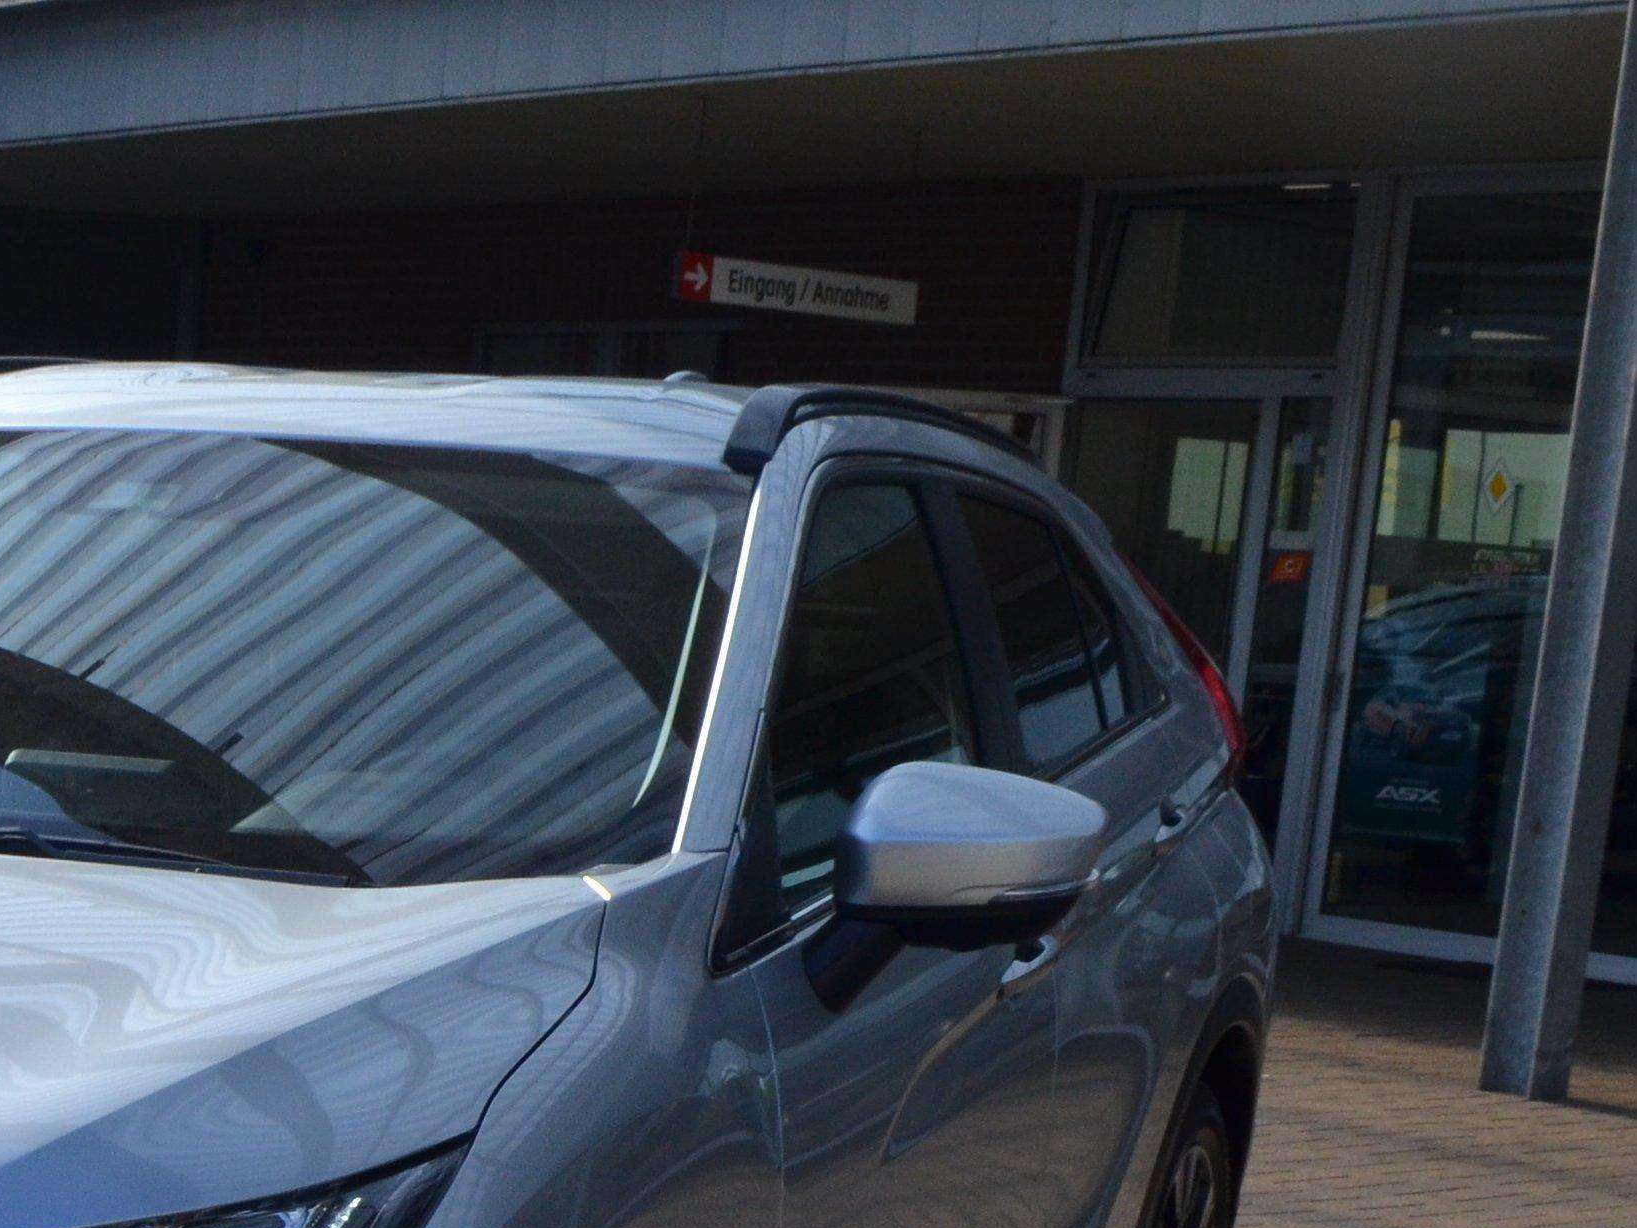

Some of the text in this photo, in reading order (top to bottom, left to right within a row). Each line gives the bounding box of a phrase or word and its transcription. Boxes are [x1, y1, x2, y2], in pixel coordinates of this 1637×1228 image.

[728, 269, 890, 311] Eingang / Annahme
[1375, 785, 1442, 804] ASX
